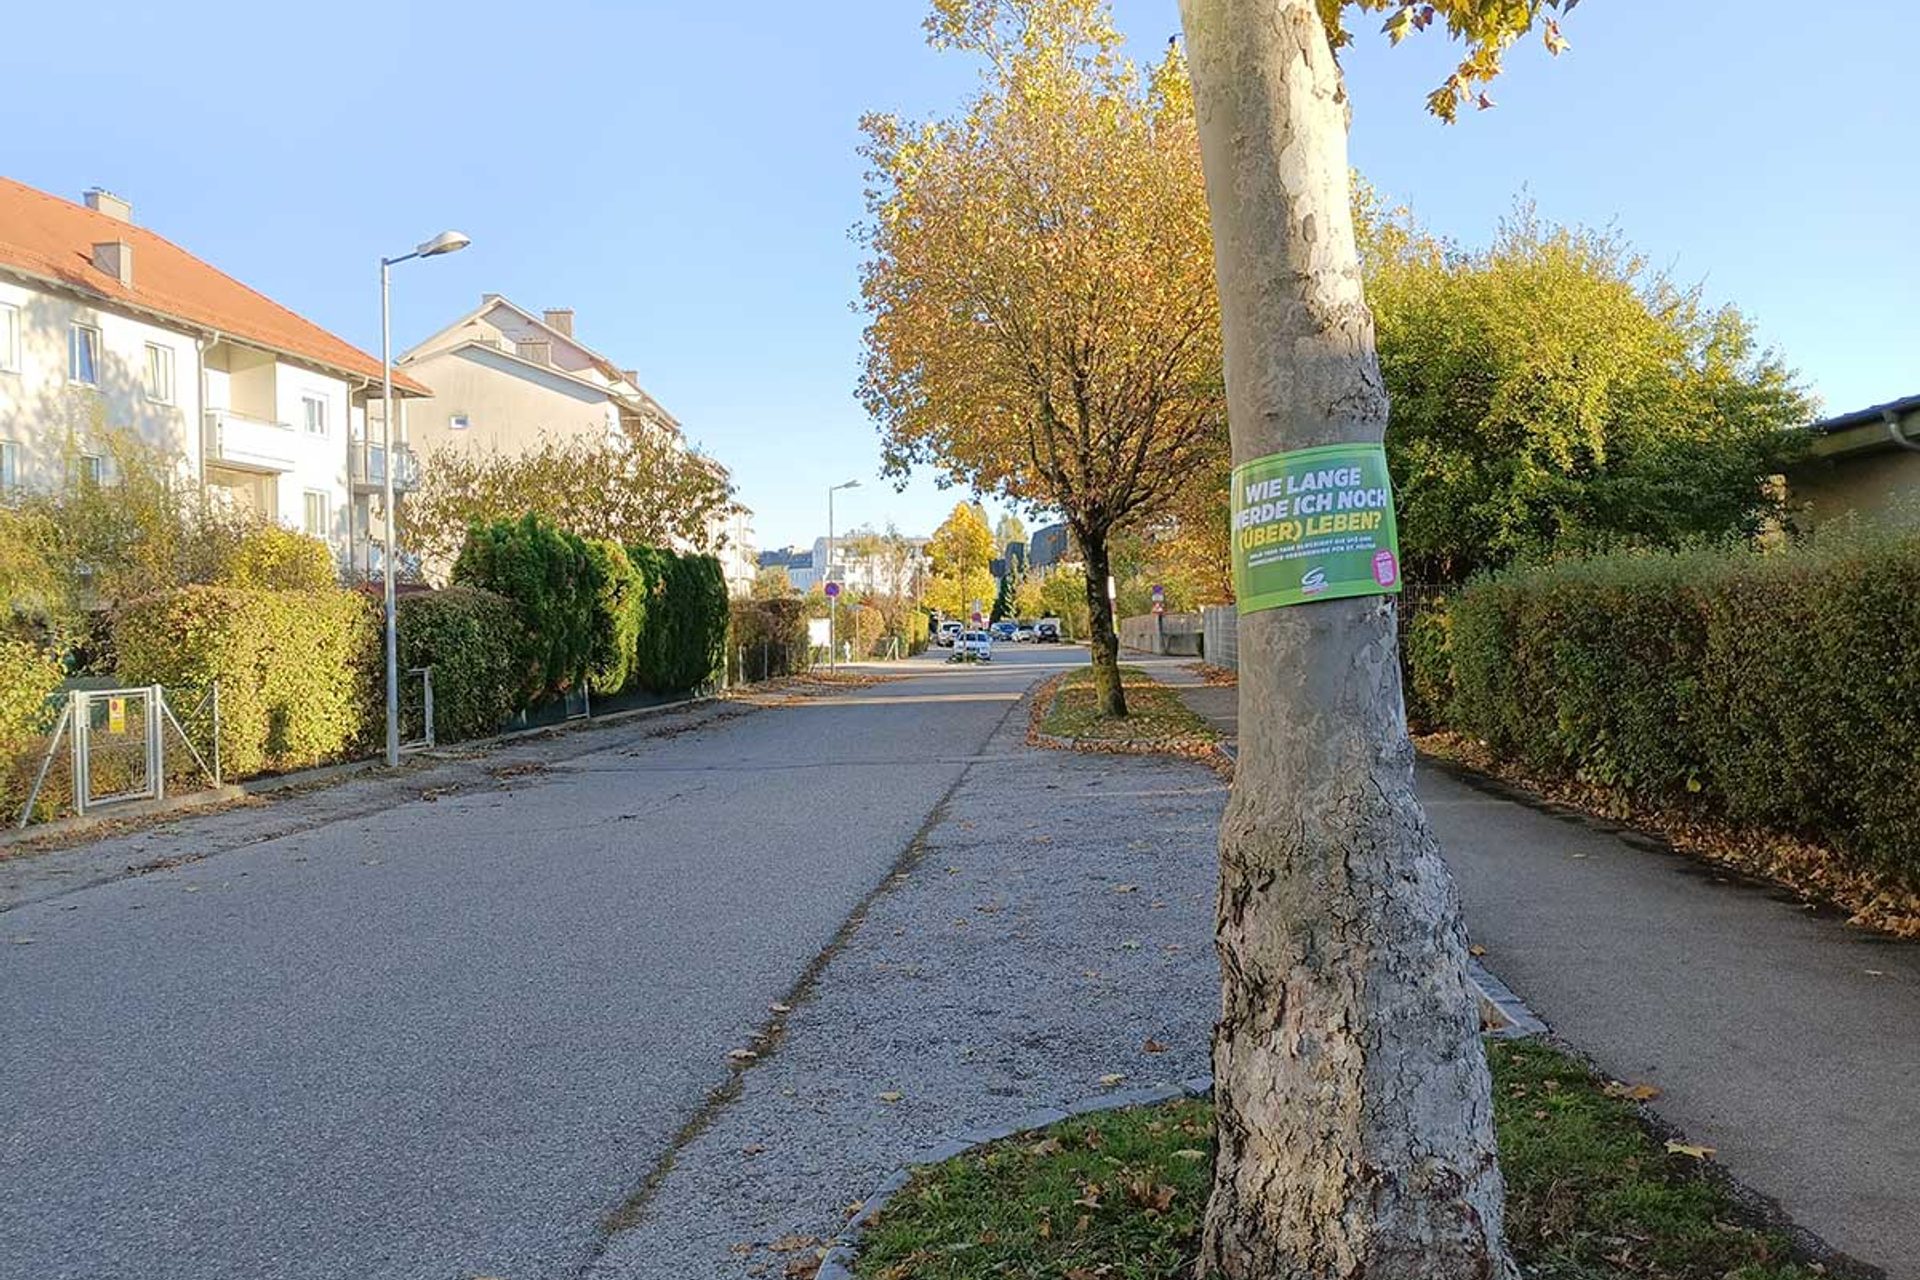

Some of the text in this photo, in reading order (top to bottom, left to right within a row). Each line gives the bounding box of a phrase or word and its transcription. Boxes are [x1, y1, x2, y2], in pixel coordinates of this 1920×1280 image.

[1246, 467, 1361, 503] WIE LANGE
[1293, 492, 1333, 515] ICH
[1337, 488, 1387, 510] NOCH
[1306, 511, 1381, 535] LEBEN?
